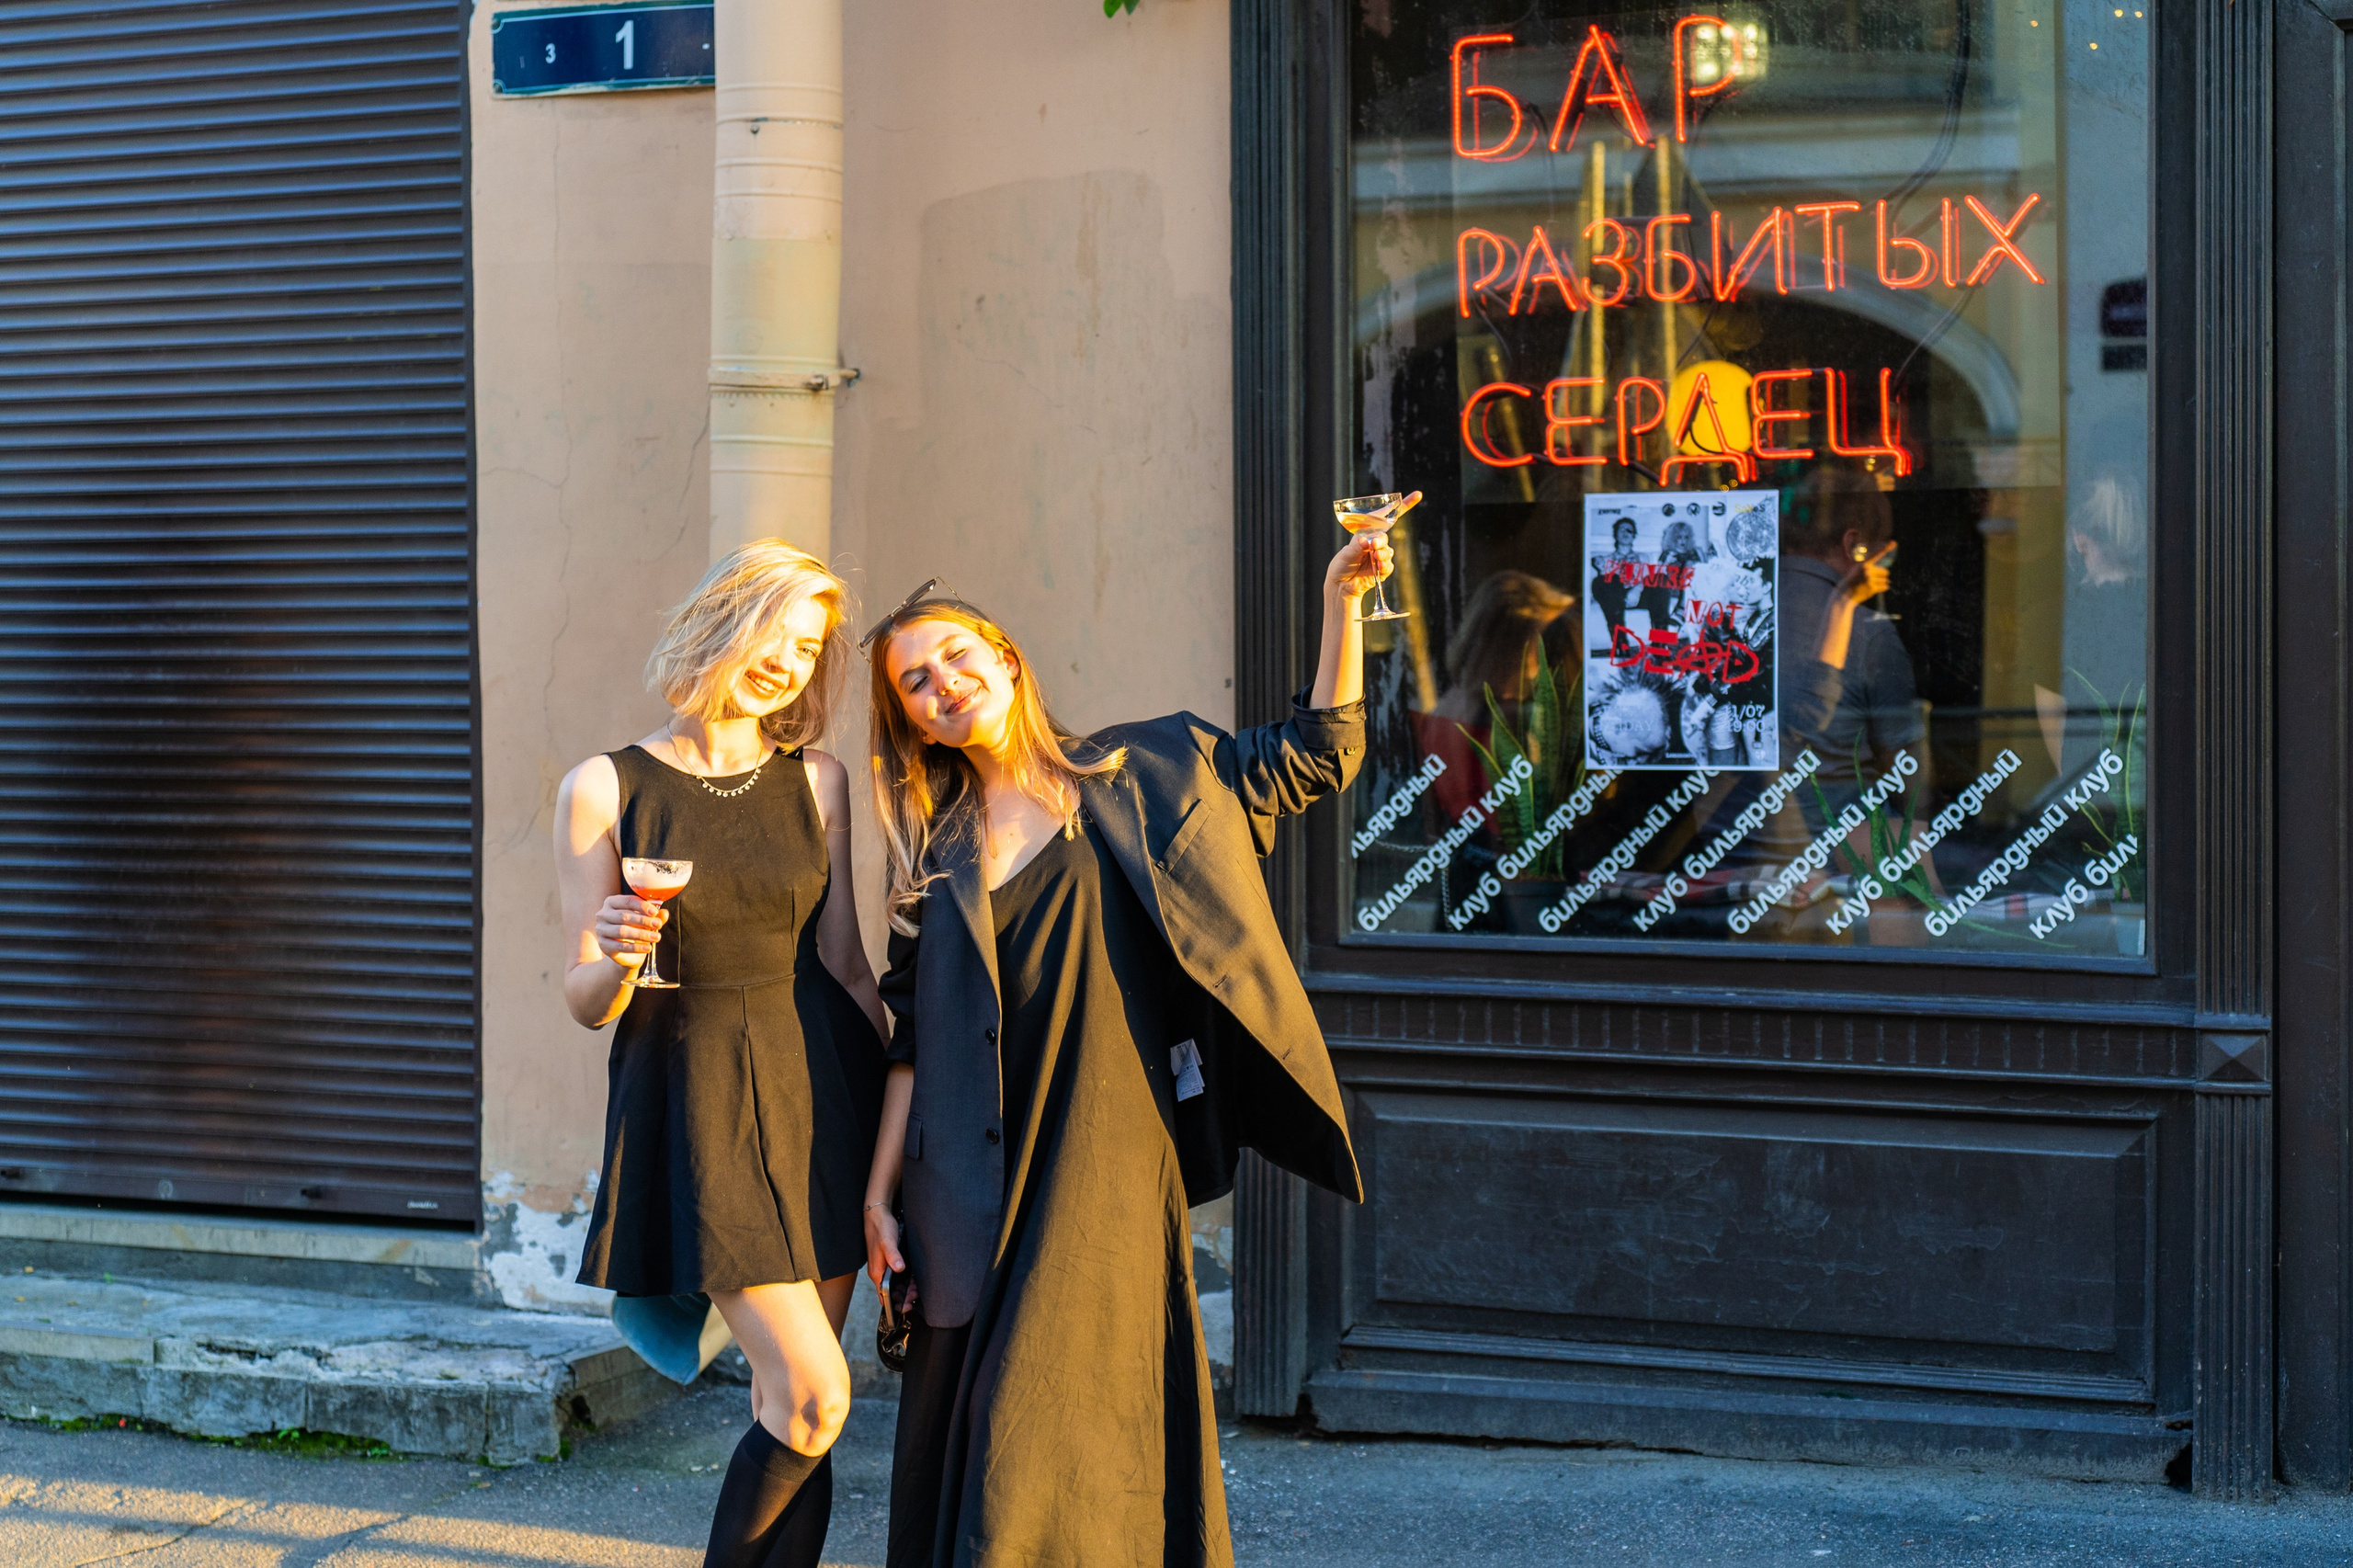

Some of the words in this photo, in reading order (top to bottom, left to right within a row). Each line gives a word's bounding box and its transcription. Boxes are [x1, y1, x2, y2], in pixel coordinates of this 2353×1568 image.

[545, 43, 556, 64] 3
[615, 20, 634, 70] 1
[1452, 15, 1743, 157] БАР
[1458, 194, 2044, 317] РАЗБИТЫХ
[1461, 368, 1909, 486] СЕРДЕЦ
[1684, 599, 1743, 629] NOT
[1609, 624, 1759, 683] DEAD
[1479, 754, 1533, 812] клуб
[1861, 749, 1919, 812] клуб
[2063, 747, 2123, 812] клуб
[1449, 871, 1502, 931] клуб
[1496, 769, 1623, 880] бильярдны
[1633, 871, 1688, 932] клуб
[1825, 874, 1882, 936] клуб
[2029, 877, 2088, 939] клуб
